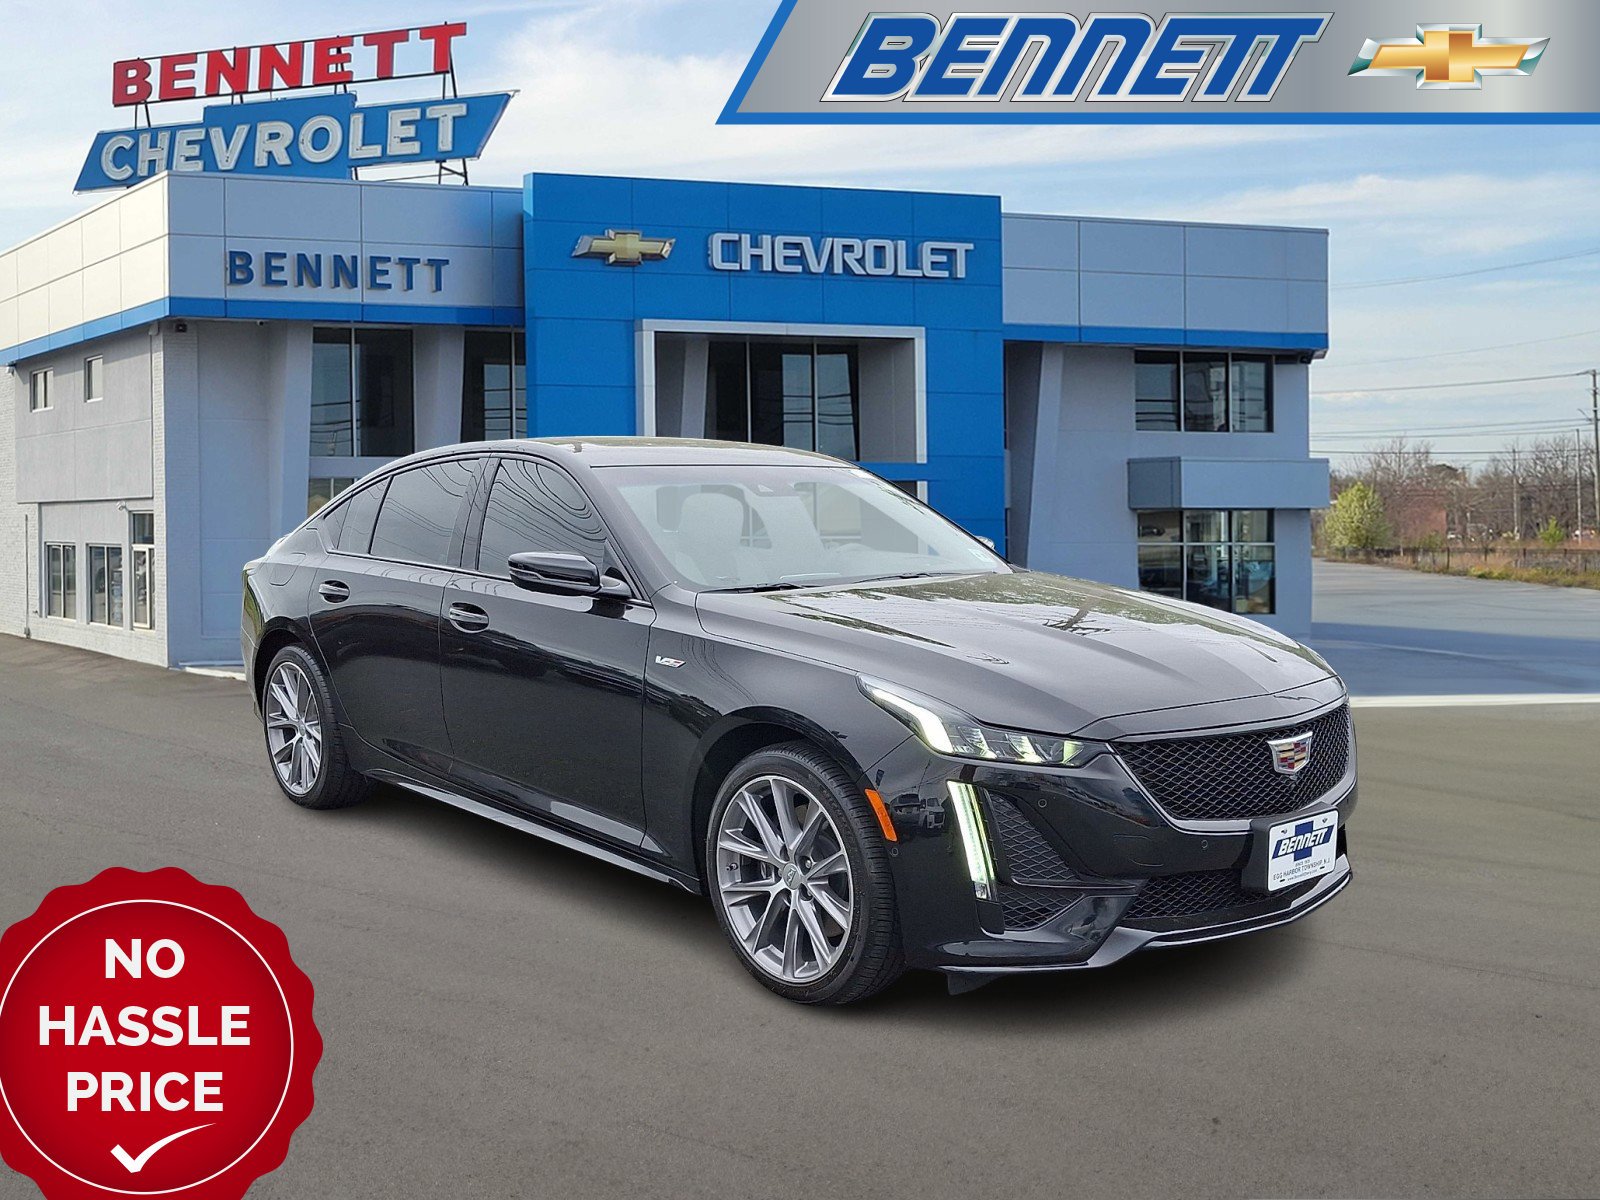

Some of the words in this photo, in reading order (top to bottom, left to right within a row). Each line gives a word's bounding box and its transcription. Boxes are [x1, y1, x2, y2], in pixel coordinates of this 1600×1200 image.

[112, 22, 467, 106] BENNETT
[100, 103, 467, 181] CHEVROLET
[226, 250, 450, 292] BENNETT
[708, 232, 974, 279] CHEVROLET
[1278, 828, 1328, 856] BENNETT
